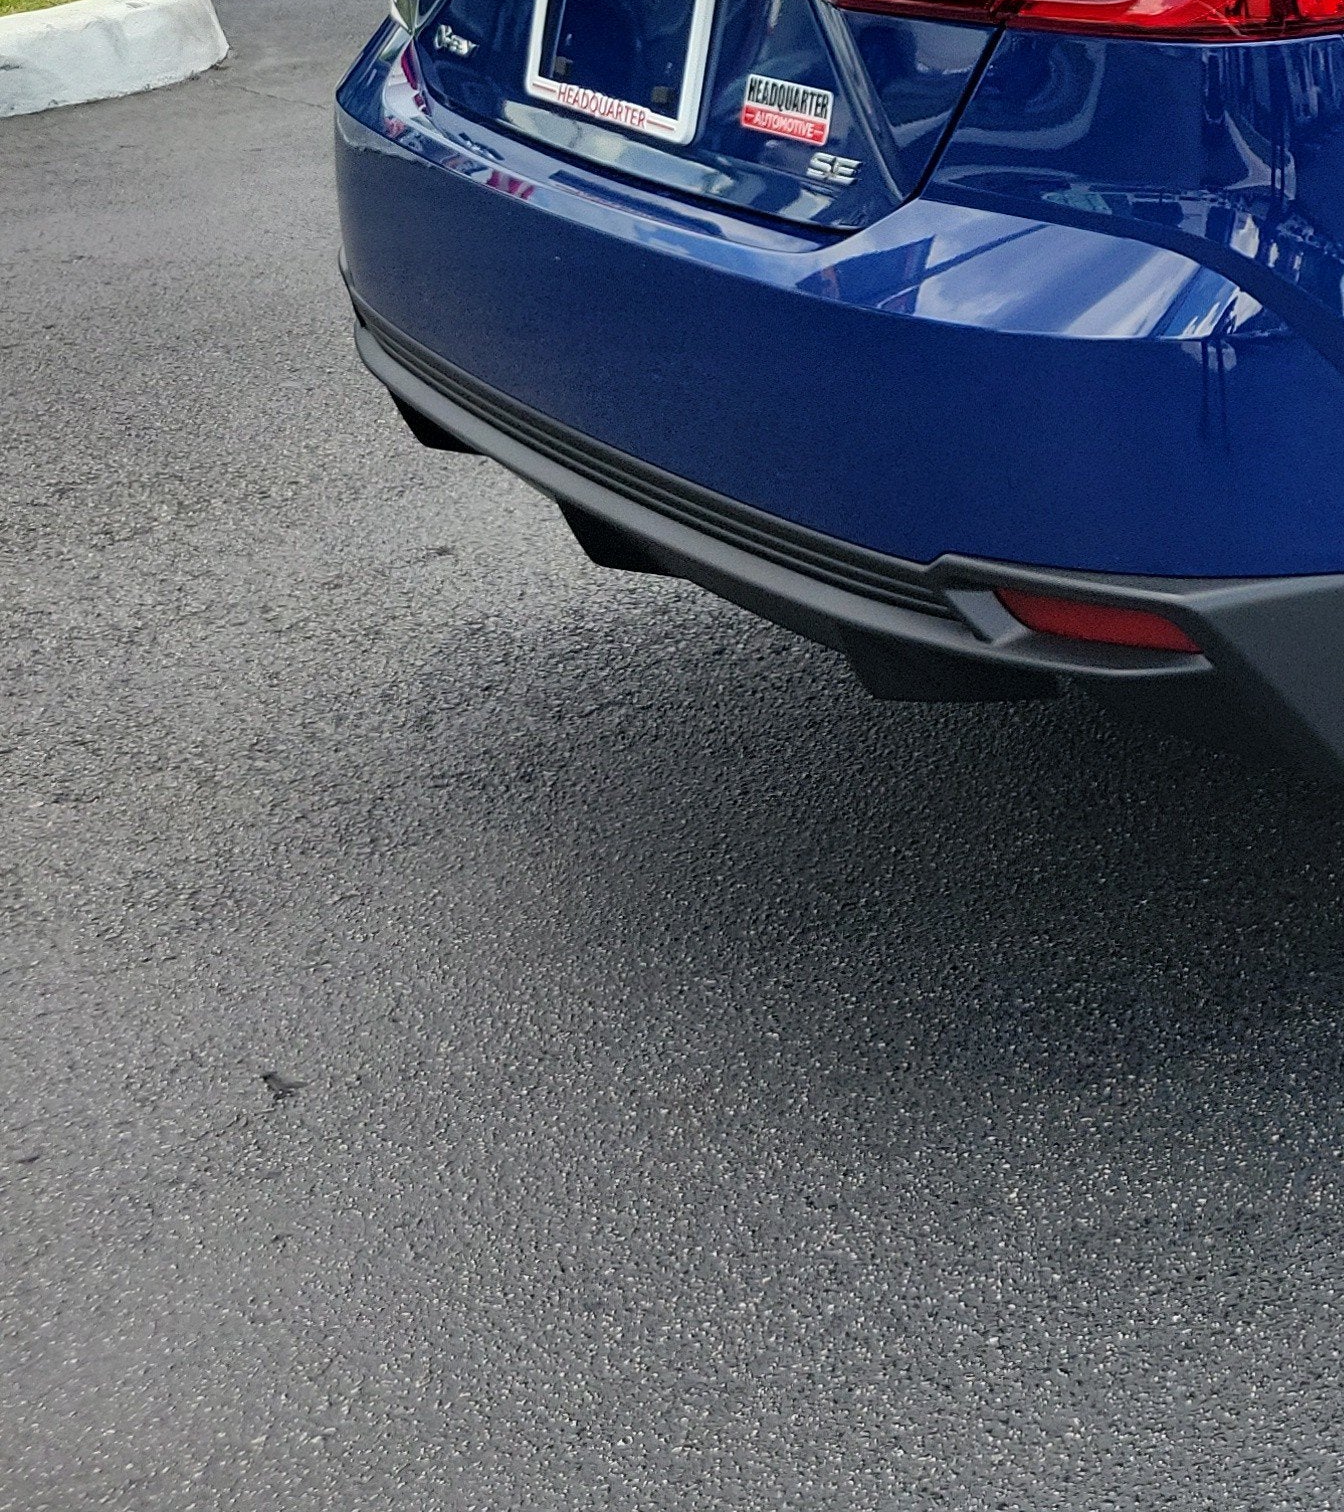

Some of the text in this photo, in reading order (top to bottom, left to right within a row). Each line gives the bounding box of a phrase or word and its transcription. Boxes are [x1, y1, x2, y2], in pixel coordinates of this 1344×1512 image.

[557, 85, 647, 128] HEADQUARTER
[747, 77, 829, 119] HEADQUARTER
[753, 109, 815, 138] AUTOMOTIVE
[806, 152, 863, 186] SE
